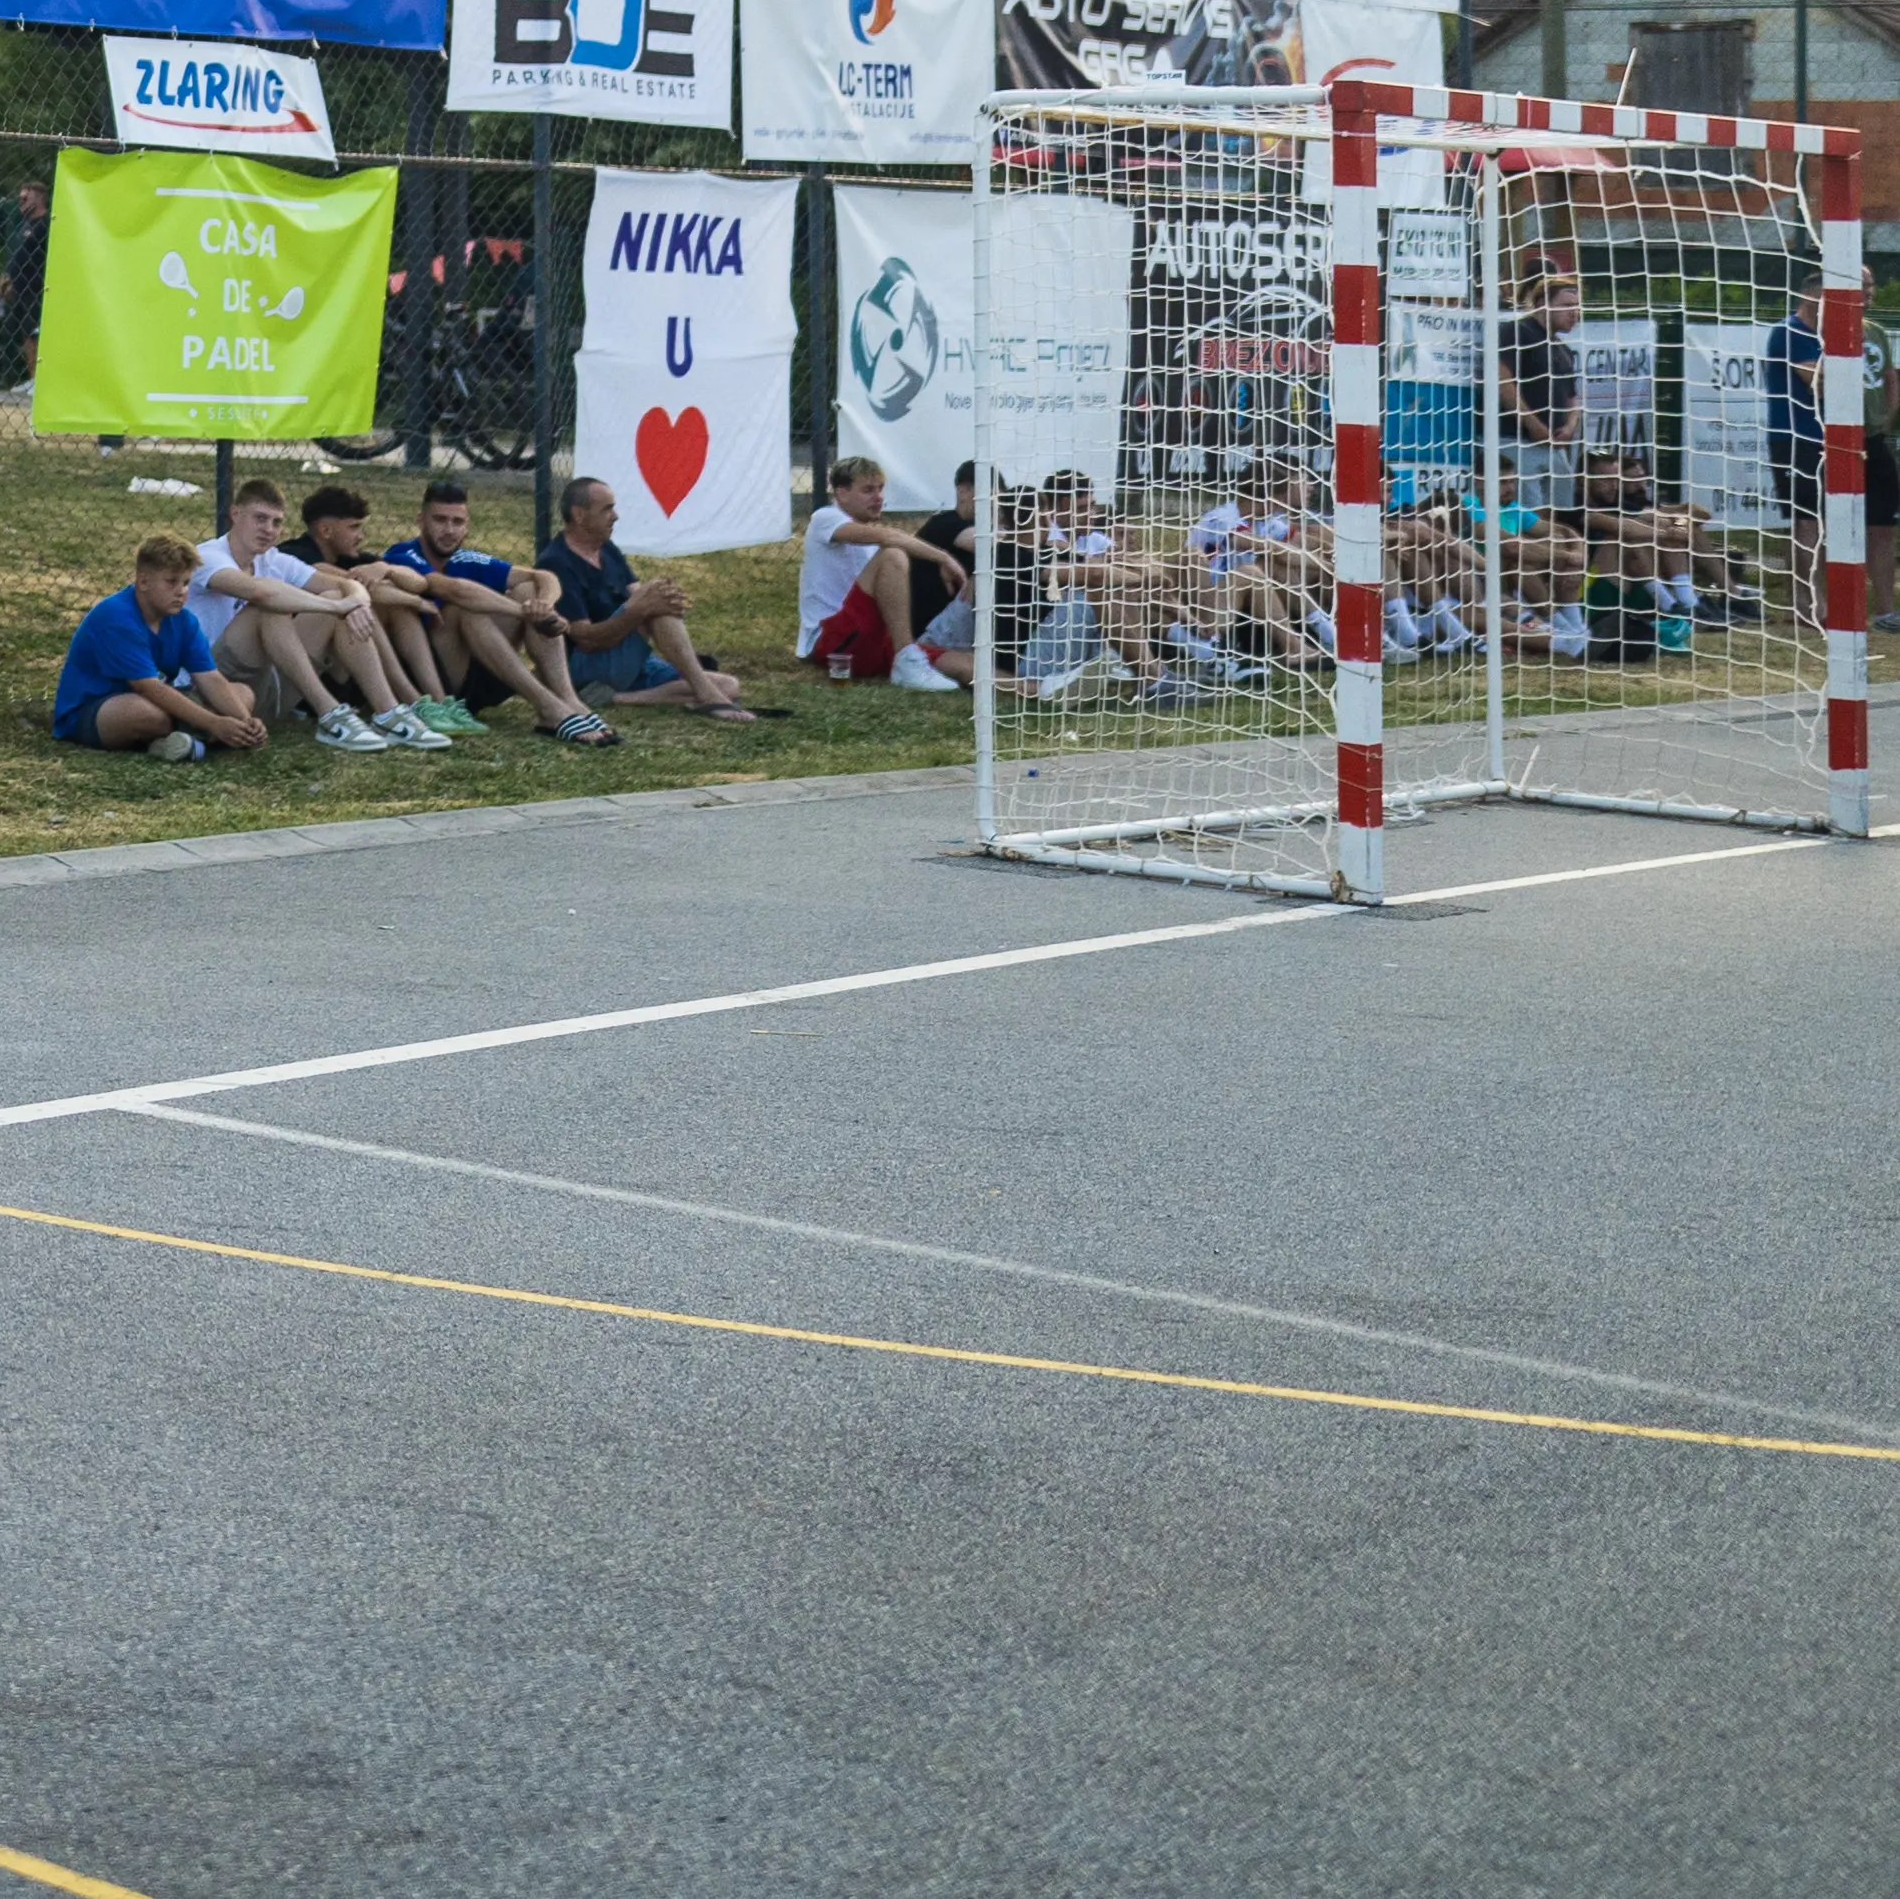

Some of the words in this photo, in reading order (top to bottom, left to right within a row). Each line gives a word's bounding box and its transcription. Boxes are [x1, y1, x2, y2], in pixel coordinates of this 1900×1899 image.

[134, 58, 285, 114] ZLARING
[592, 71, 629, 94] REAL
[636, 79, 696, 99] ESTATE
[842, 102, 916, 119] STALACIJE
[199, 218, 277, 259] CASA
[609, 211, 743, 275] NIKKA
[1145, 219, 1329, 281] AUTOSER
[223, 278, 252, 313] DE
[182, 334, 275, 373] PADEL
[665, 316, 693, 378] U
